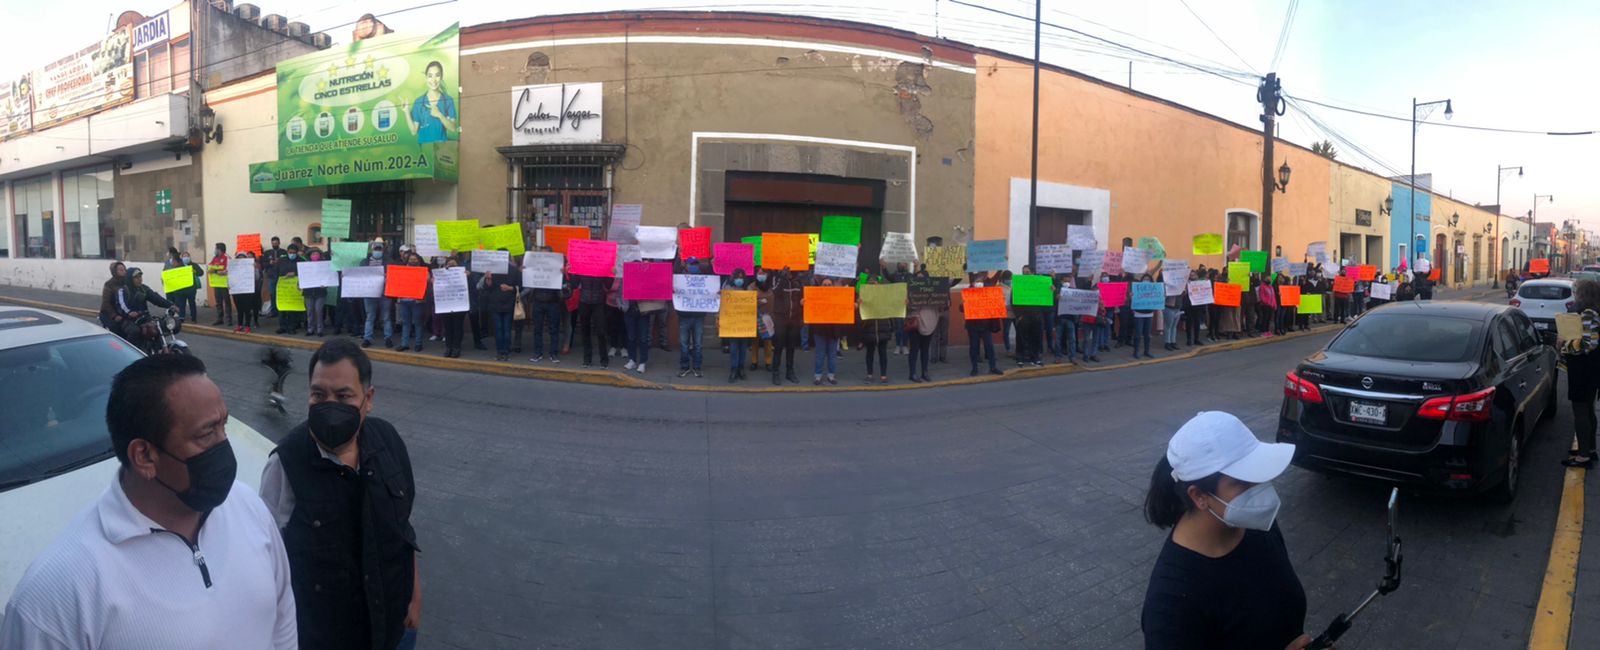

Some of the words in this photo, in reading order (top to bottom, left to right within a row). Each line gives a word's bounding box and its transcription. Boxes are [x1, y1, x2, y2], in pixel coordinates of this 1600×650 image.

[329, 71, 374, 87] NUTRICIÓN
[314, 90, 338, 100] CINCO
[339, 79, 392, 96] ESTRELLAS
[514, 88, 559, 130] Carlos
[560, 83, 600, 130] Vargas
[295, 145, 318, 153] TIENDA
[334, 138, 361, 149] ATIENDE
[374, 134, 397, 143] SALUD
[318, 163, 350, 176] Norte
